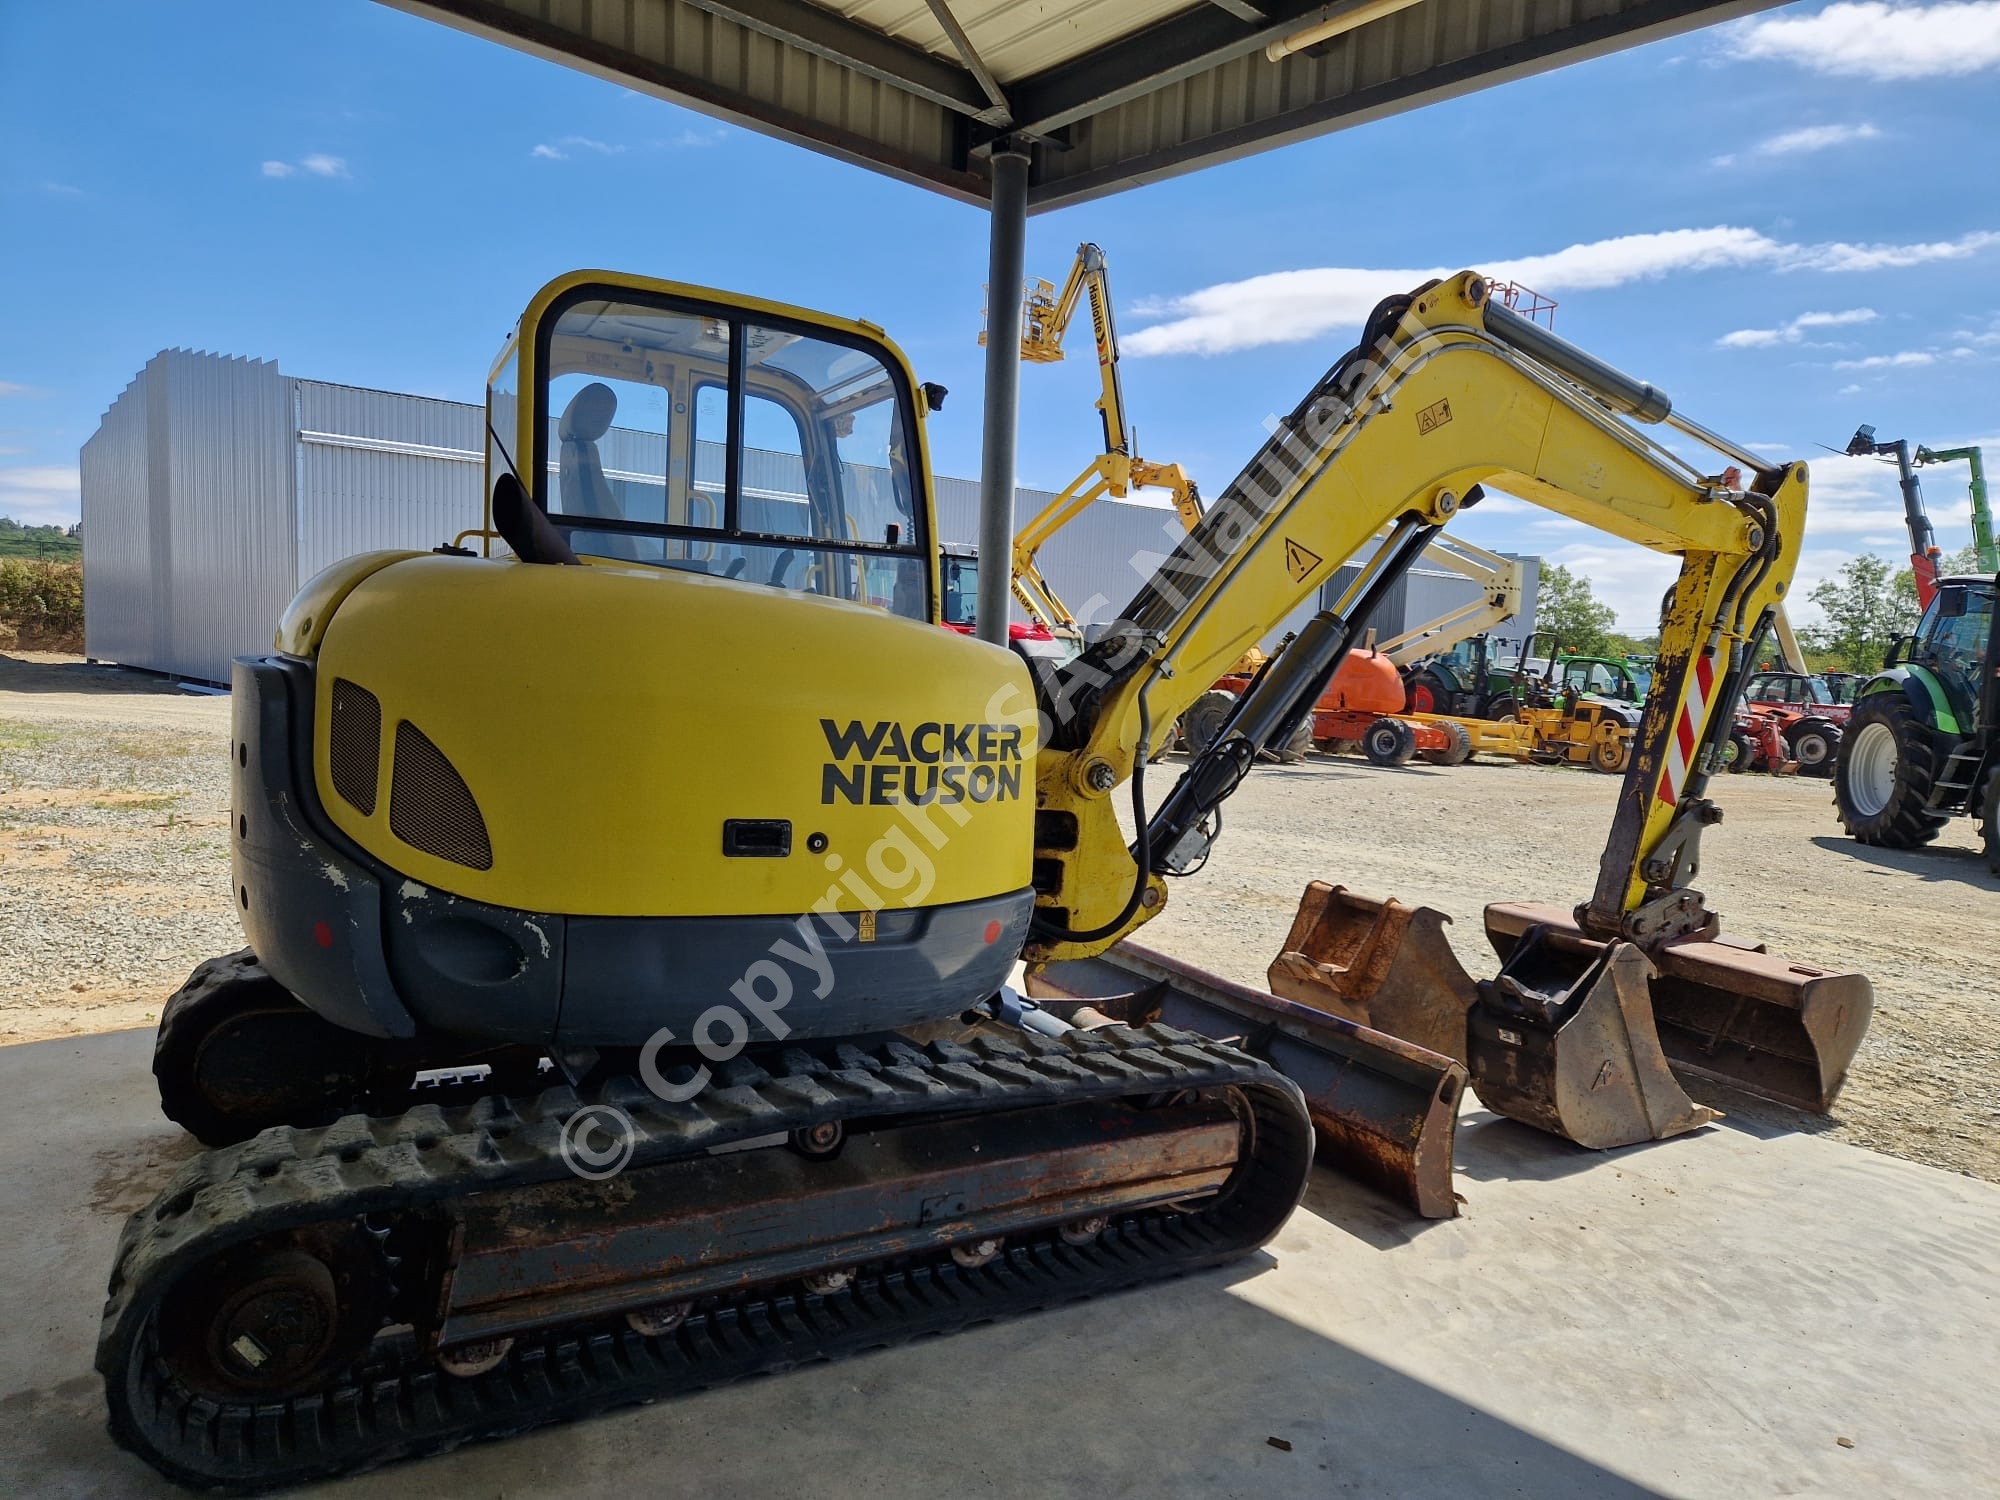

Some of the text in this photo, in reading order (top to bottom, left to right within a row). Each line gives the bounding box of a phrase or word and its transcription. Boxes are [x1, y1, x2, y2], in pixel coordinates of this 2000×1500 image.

[1088, 283, 1102, 334] Haulotte
[819, 718, 1022, 764] WACKER
[821, 763, 1022, 806] NEUSON
